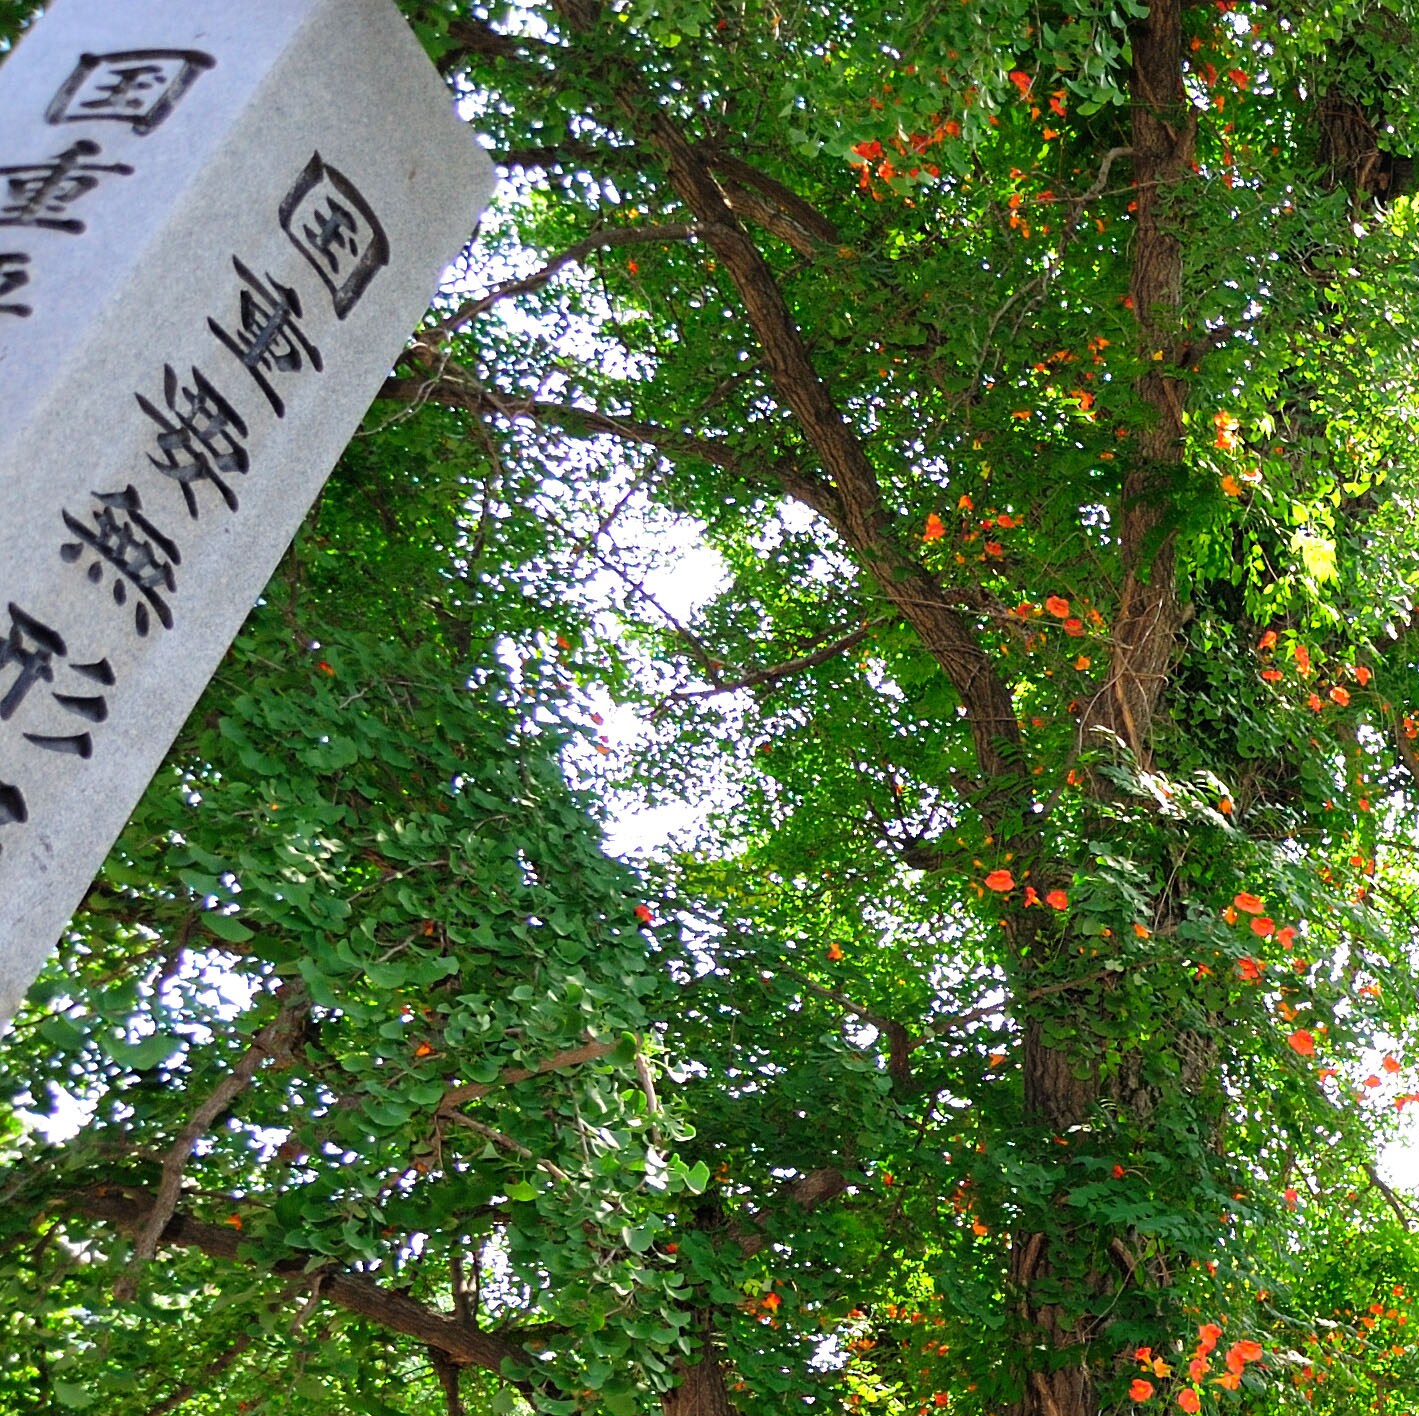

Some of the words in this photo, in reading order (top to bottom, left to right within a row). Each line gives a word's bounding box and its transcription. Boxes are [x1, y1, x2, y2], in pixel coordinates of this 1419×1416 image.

[0, 49, 217, 318] 国重
[0, 150, 390, 823] 国重要無形
